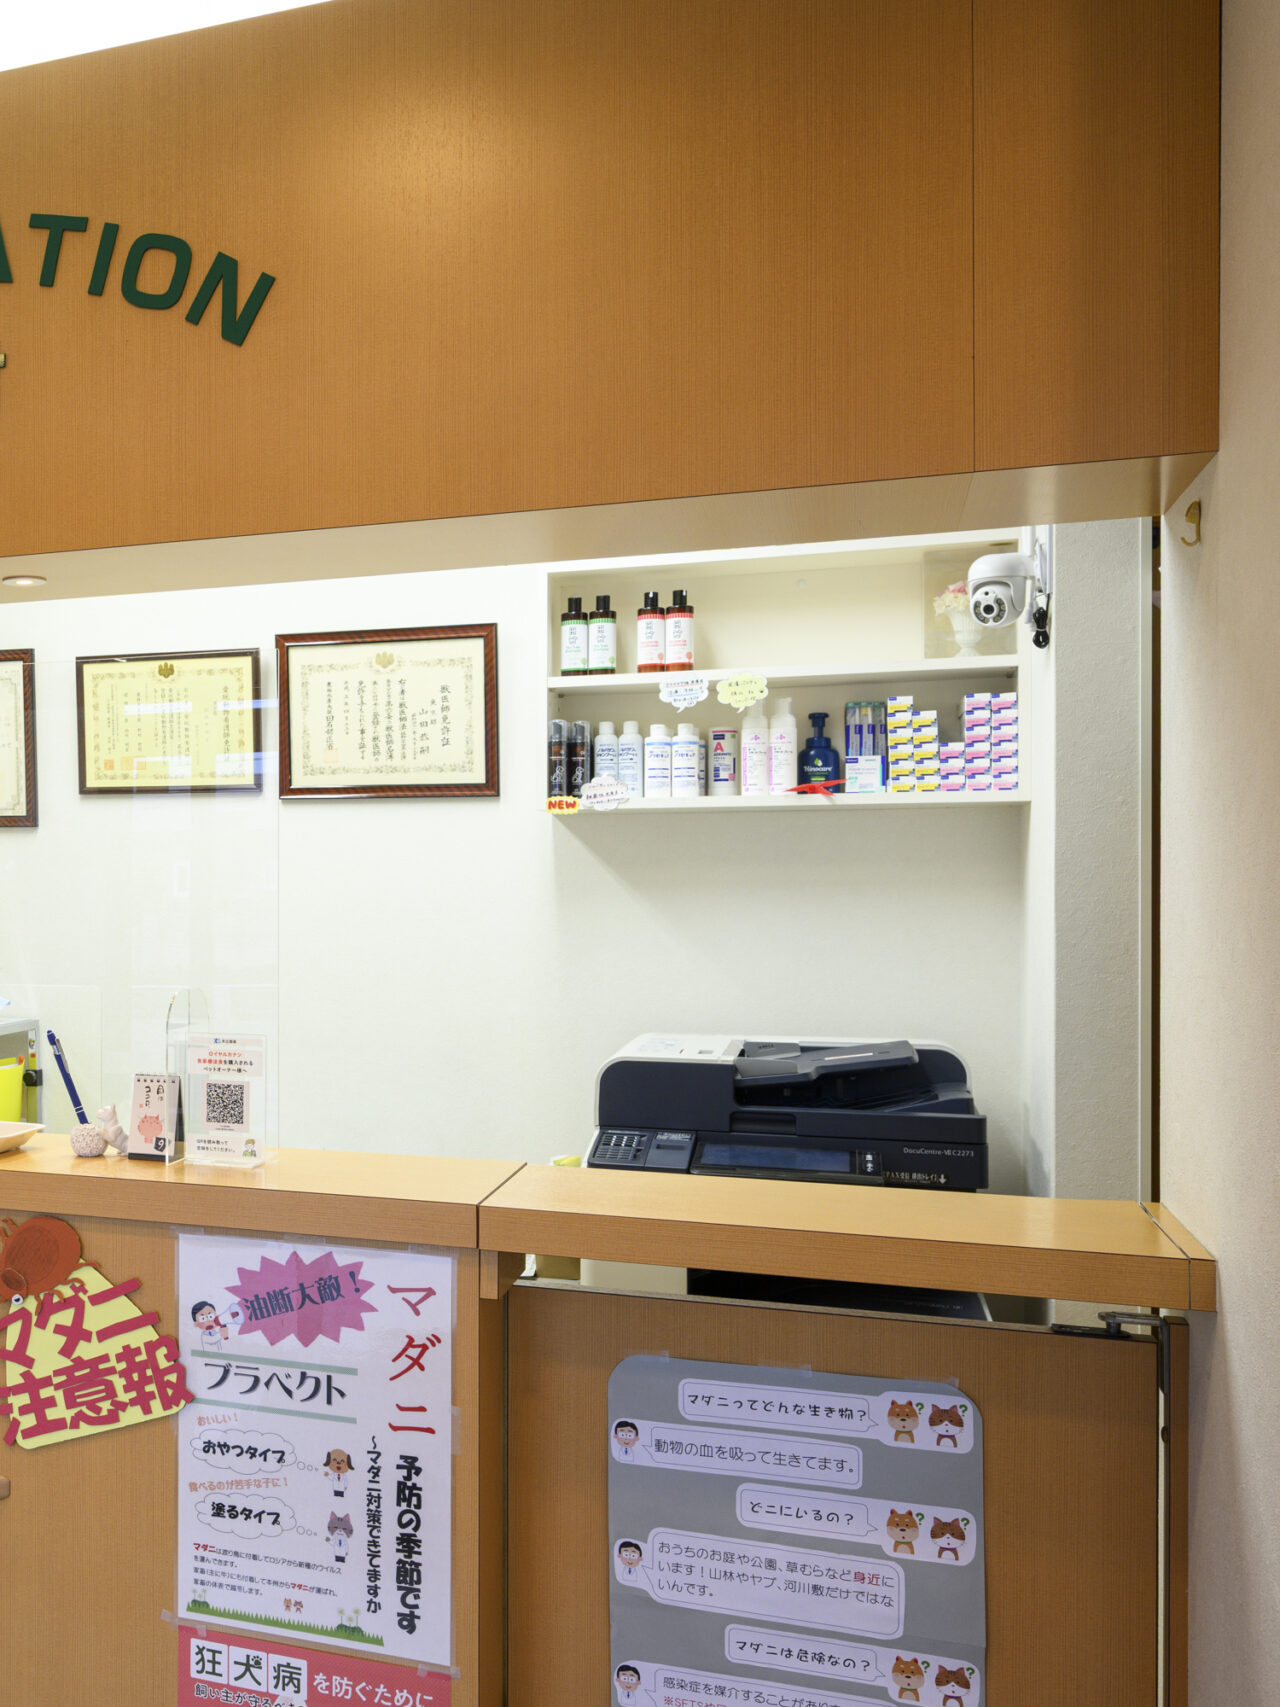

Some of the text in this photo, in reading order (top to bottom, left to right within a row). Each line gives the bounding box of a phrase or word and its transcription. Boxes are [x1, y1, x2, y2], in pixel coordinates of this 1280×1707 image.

[547, 799, 577, 810] NEW
[243, 1270, 362, 1322] 油断大敵！
[204, 1361, 347, 1406] ブラベクト
[196, 1412, 239, 1427] おいしい！
[687, 1393, 867, 1422] マダニってどんな生き物？
[202, 1439, 286, 1465] おやつタイプ
[387, 1284, 442, 1636] マダニ 予防の季節です
[654, 1438, 855, 1474] 動物の血を吸って生きてます。
[211, 1501, 281, 1526] 塗るタイプ
[750, 1501, 854, 1526] どこにいるの？
[658, 1541, 895, 1589] おうちのお庭や公園、草むらなど身近に
[658, 1562, 894, 1608] います！山林やヤブ、河川敷だけではな
[658, 1579, 715, 1598] いんです。
[735, 1639, 871, 1671] マダニは危険なの？
[195, 1645, 433, 1707] 狂犬病 を防ぐために
